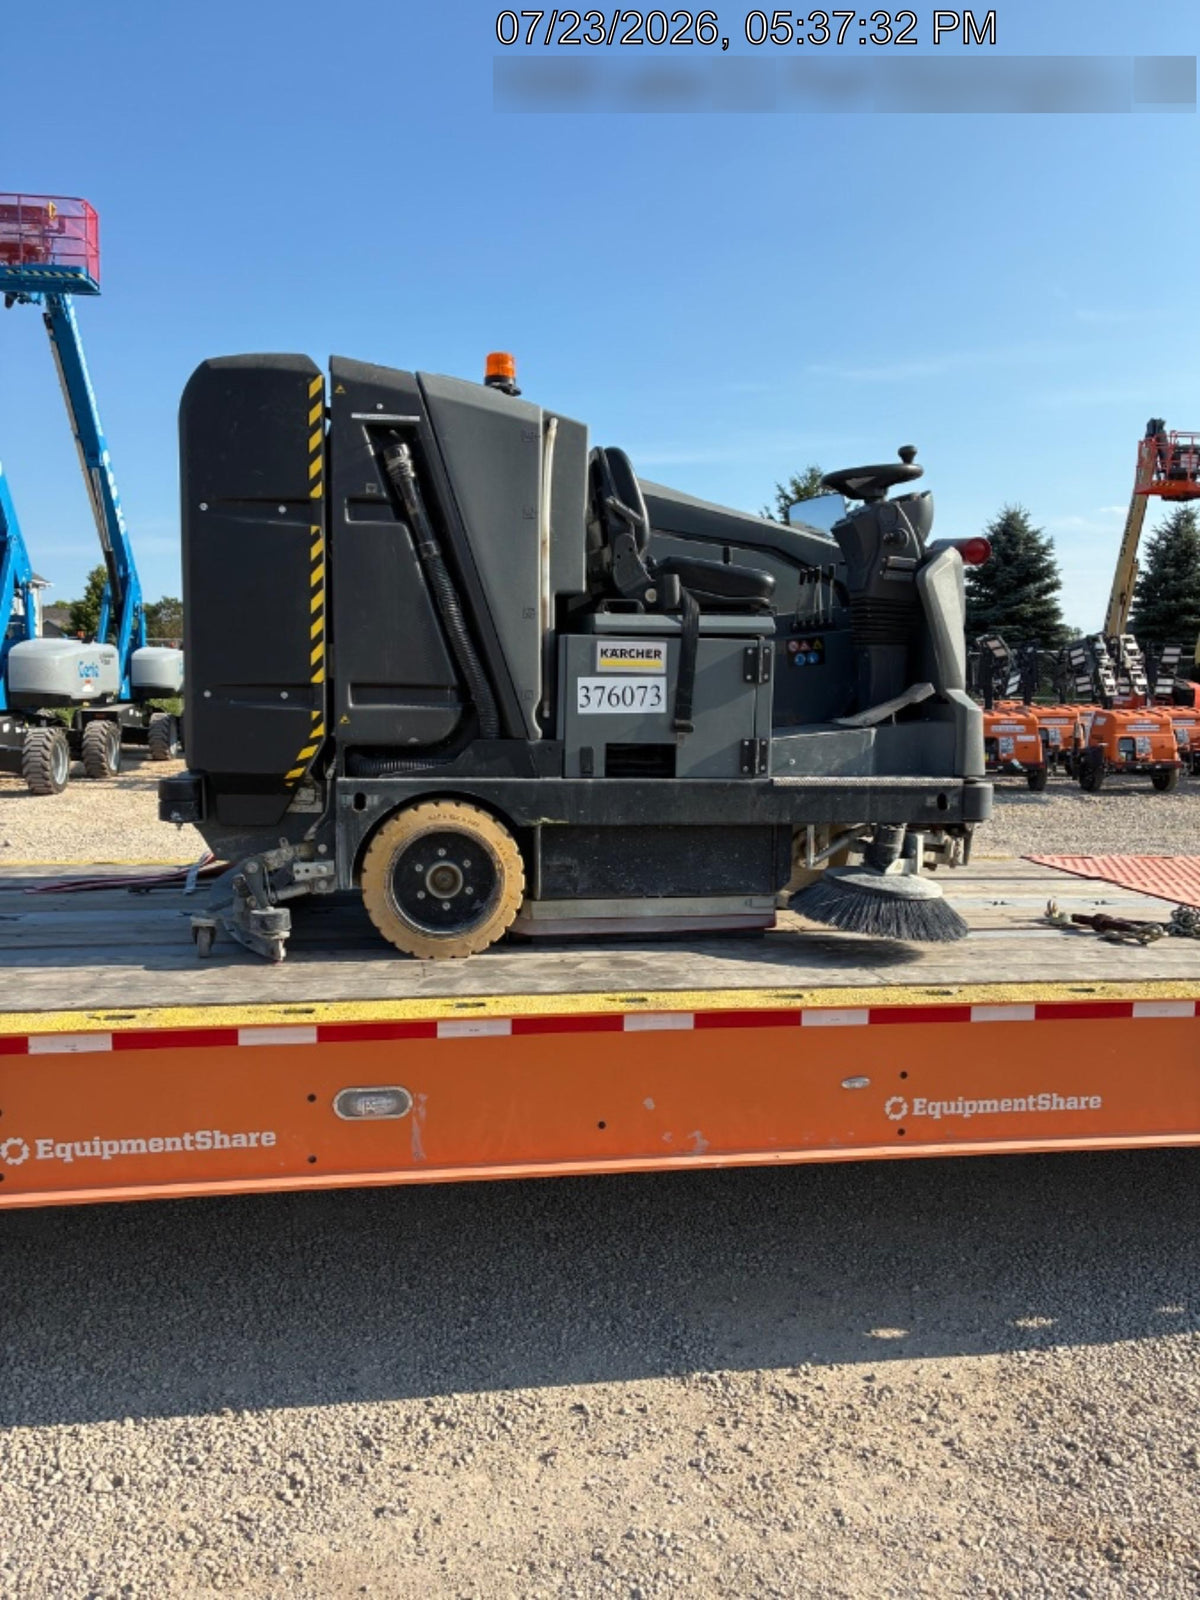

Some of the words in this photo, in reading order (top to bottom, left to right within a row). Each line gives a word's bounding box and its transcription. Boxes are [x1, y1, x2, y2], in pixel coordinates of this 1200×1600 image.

[600, 648, 662, 659] KÄRCHER
[579, 684, 662, 709] 376073
[912, 1093, 1102, 1119] EquipmentShare
[35, 1130, 276, 1162] EquipmentShare
